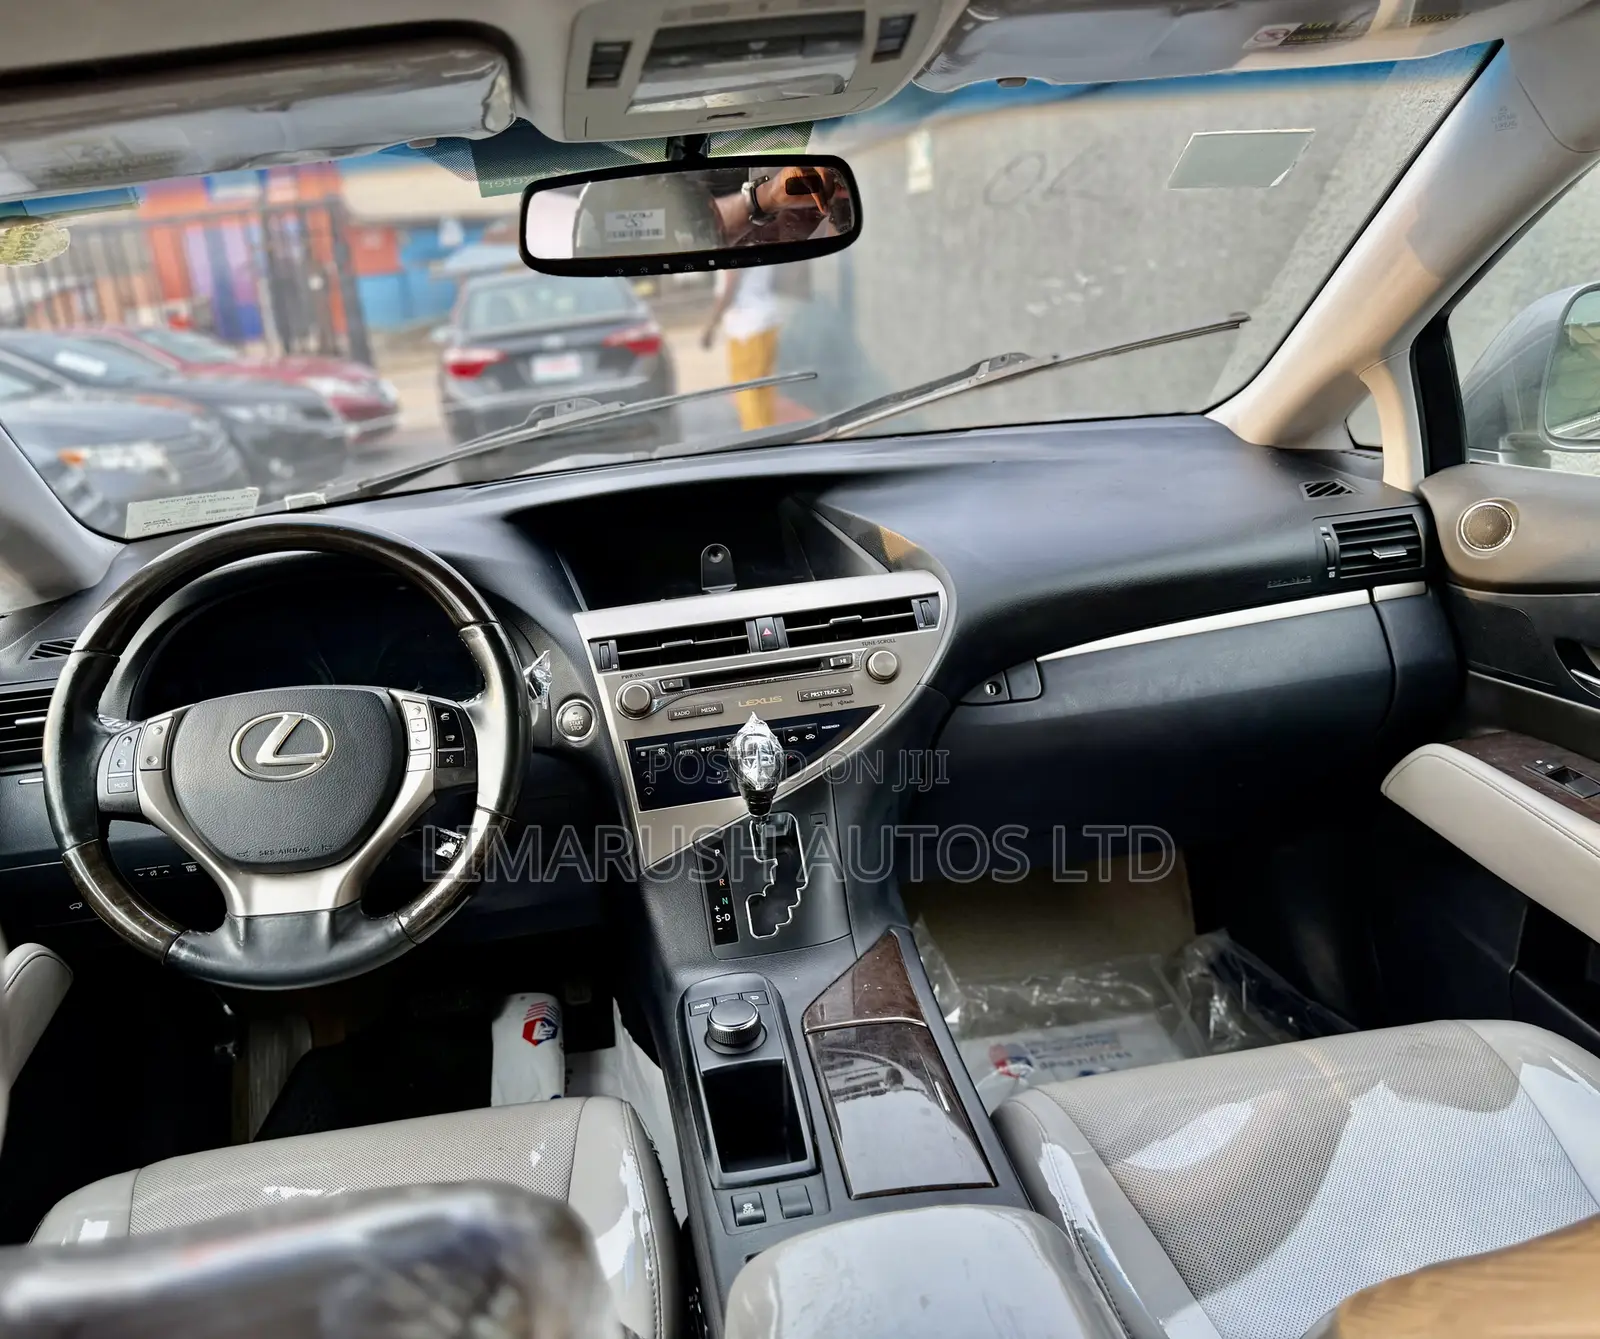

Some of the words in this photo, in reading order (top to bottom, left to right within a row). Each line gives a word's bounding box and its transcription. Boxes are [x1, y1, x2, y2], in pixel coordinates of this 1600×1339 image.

[738, 695, 783, 708] LEXUS
[674, 709, 690, 717] RADIO
[700, 706, 717, 714] MEDIA
[714, 848, 721, 857] P
[719, 878, 726, 887] R
[721, 897, 729, 905] N
